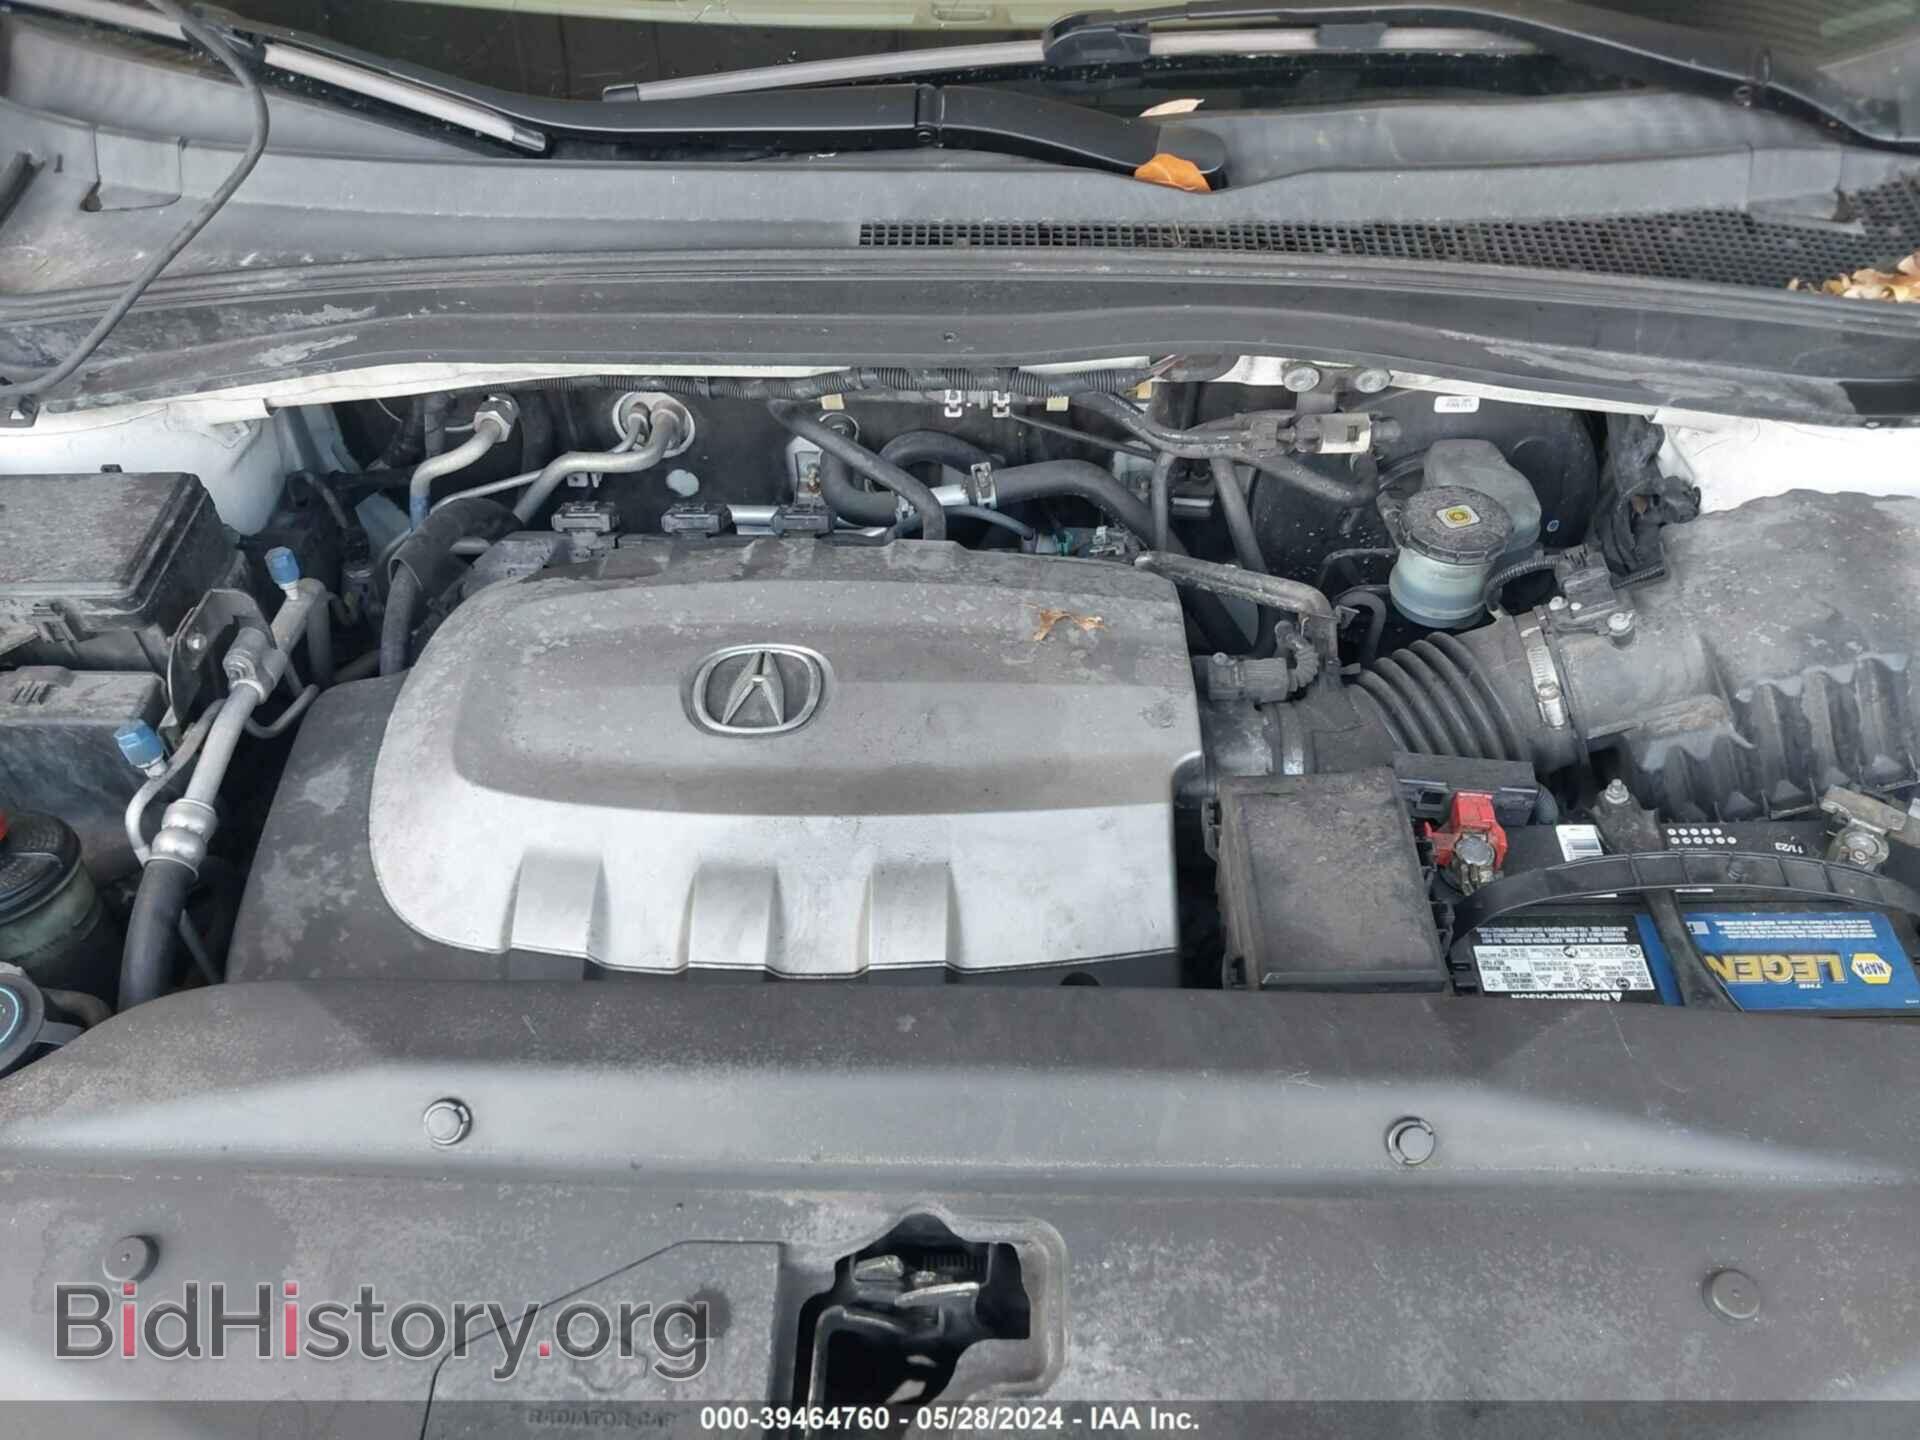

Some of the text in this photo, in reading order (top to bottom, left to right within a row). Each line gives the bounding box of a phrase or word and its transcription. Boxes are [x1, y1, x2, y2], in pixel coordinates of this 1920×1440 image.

[1704, 954, 1847, 983] LEGEN
[1856, 961, 1887, 976] NAPA
[529, 1410, 632, 1427] RADIATOR
